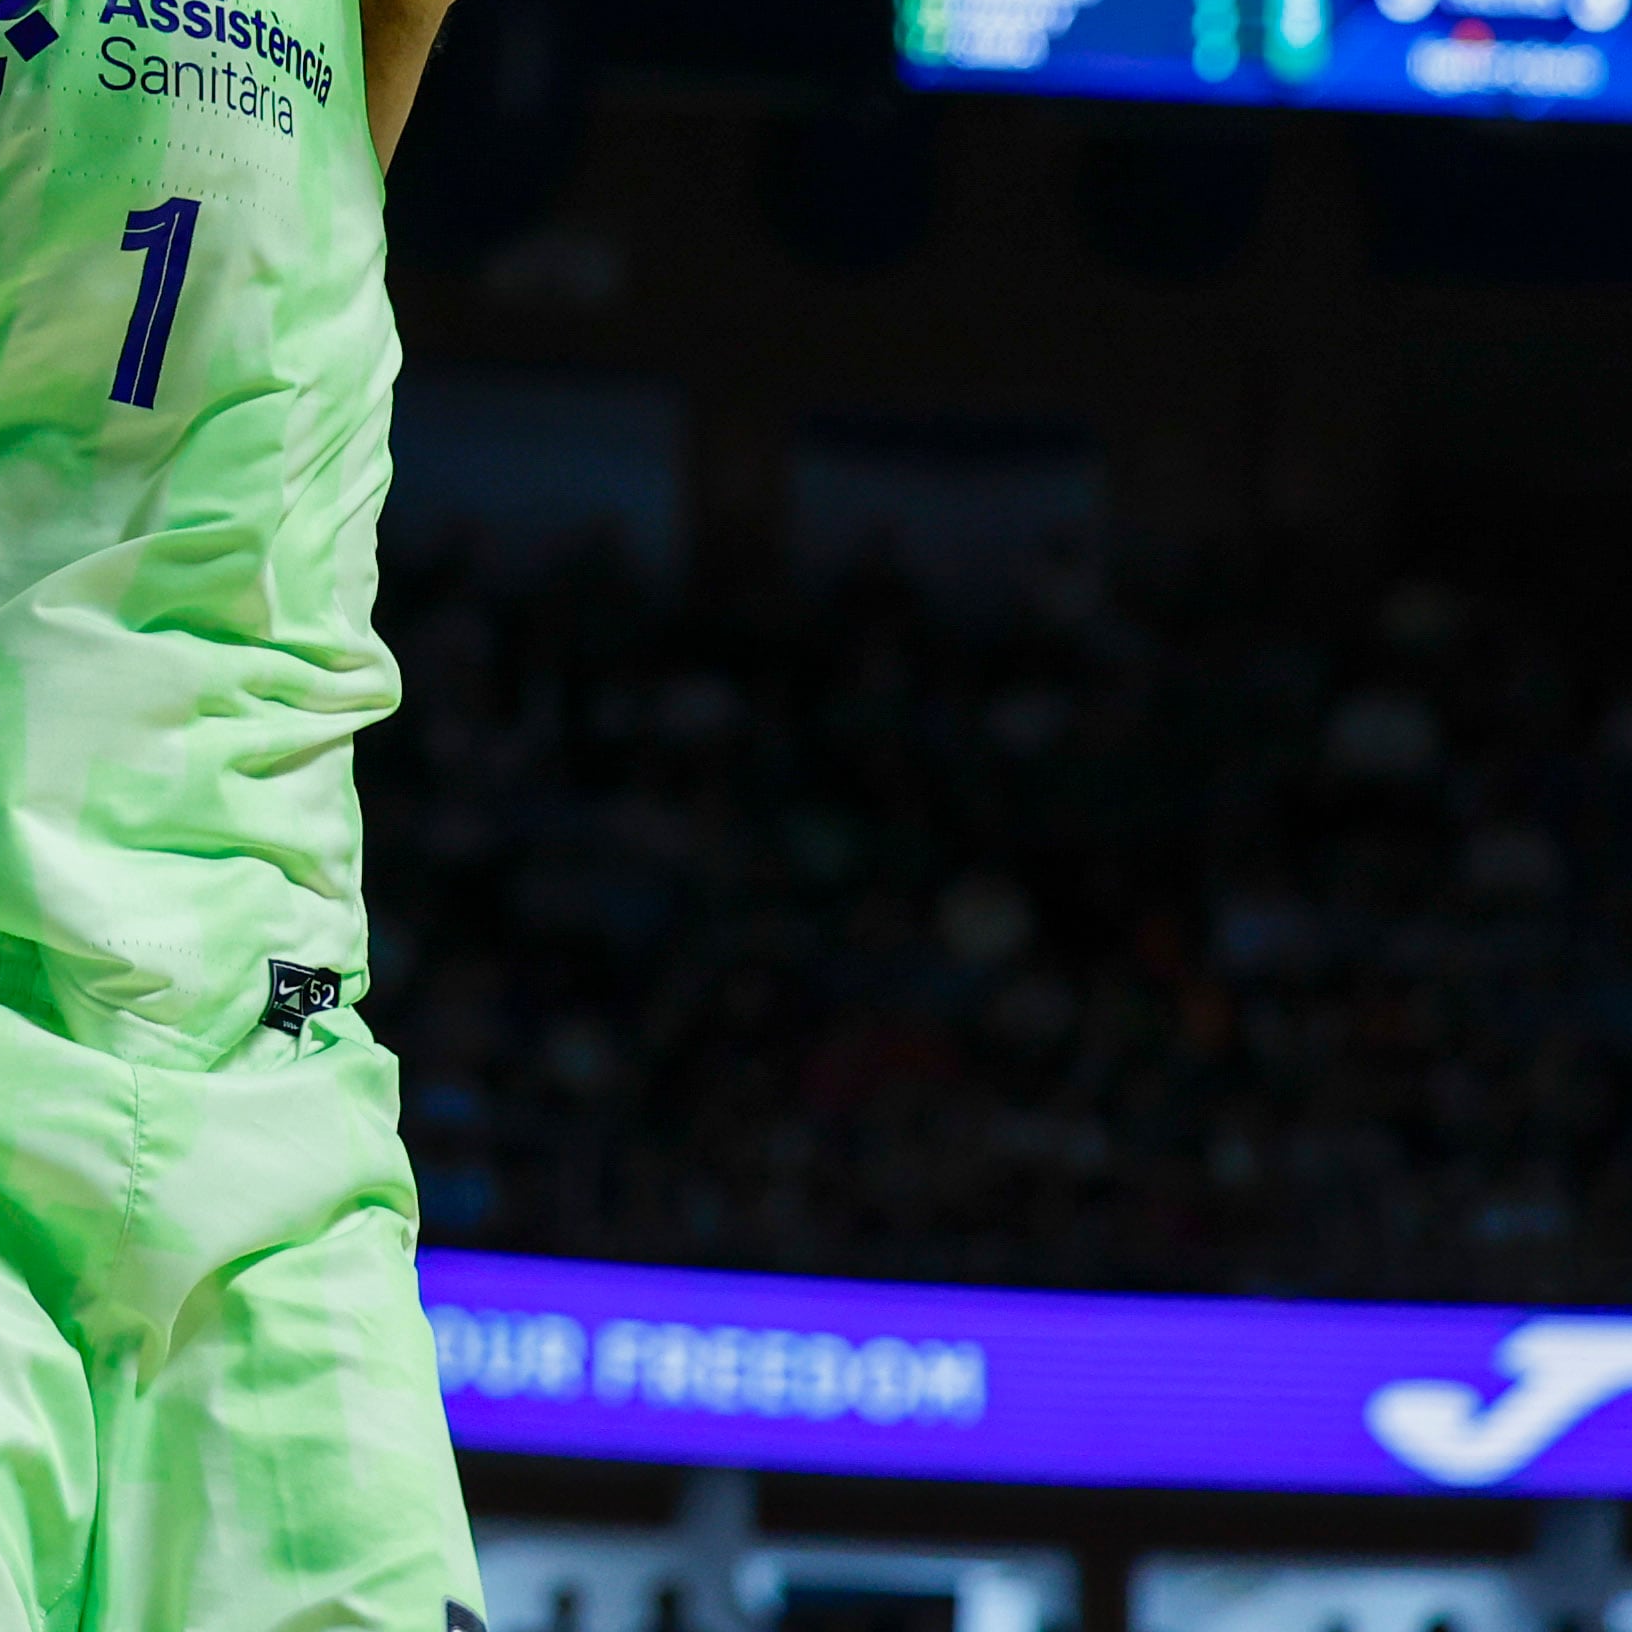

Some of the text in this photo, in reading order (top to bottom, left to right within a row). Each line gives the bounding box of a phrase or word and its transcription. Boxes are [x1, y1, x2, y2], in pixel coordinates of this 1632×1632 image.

[97, 36, 295, 138] Sanitària
[108, 196, 203, 411] 1
[309, 978, 336, 1009] 52
[596, 1320, 985, 1426] FREEDOM
